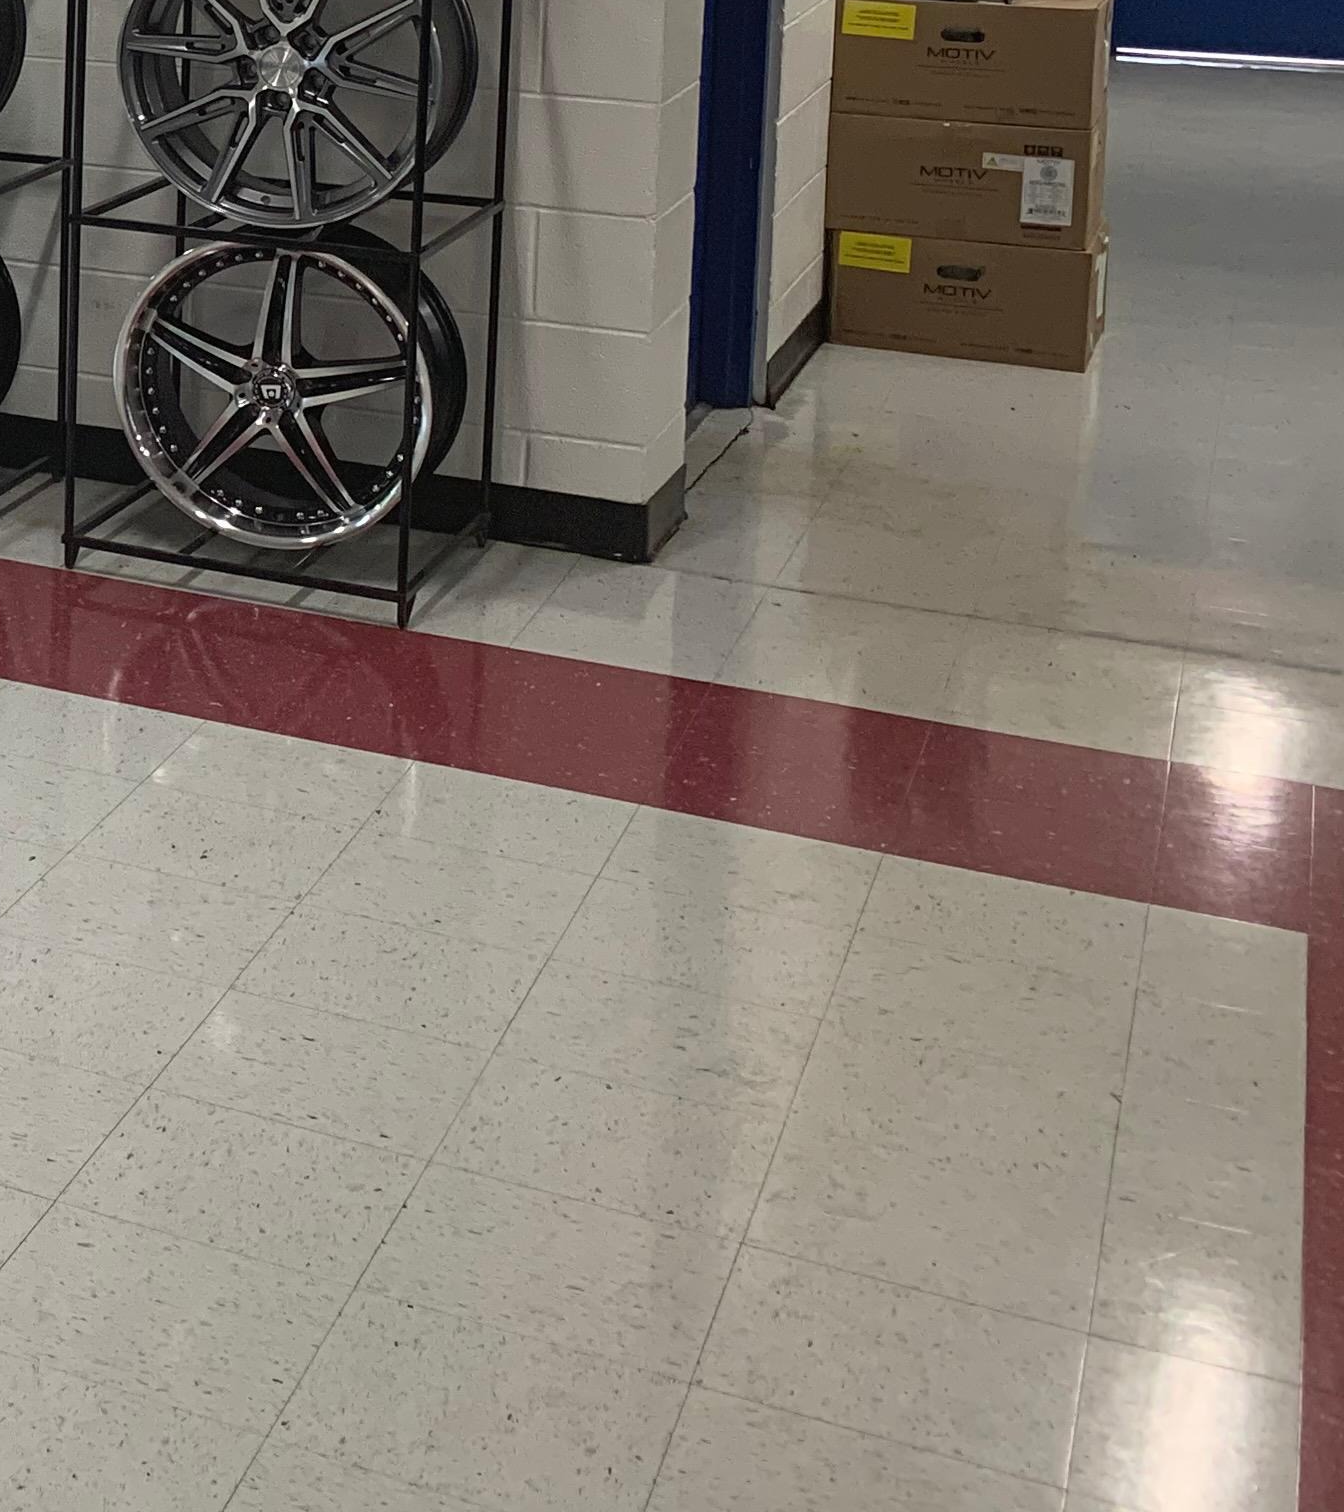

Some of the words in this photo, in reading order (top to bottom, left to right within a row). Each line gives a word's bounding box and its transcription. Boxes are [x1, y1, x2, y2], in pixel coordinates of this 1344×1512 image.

[926, 46, 996, 61] MOTIV
[920, 165, 988, 180] MOTIV
[923, 283, 992, 299] MOTIV
